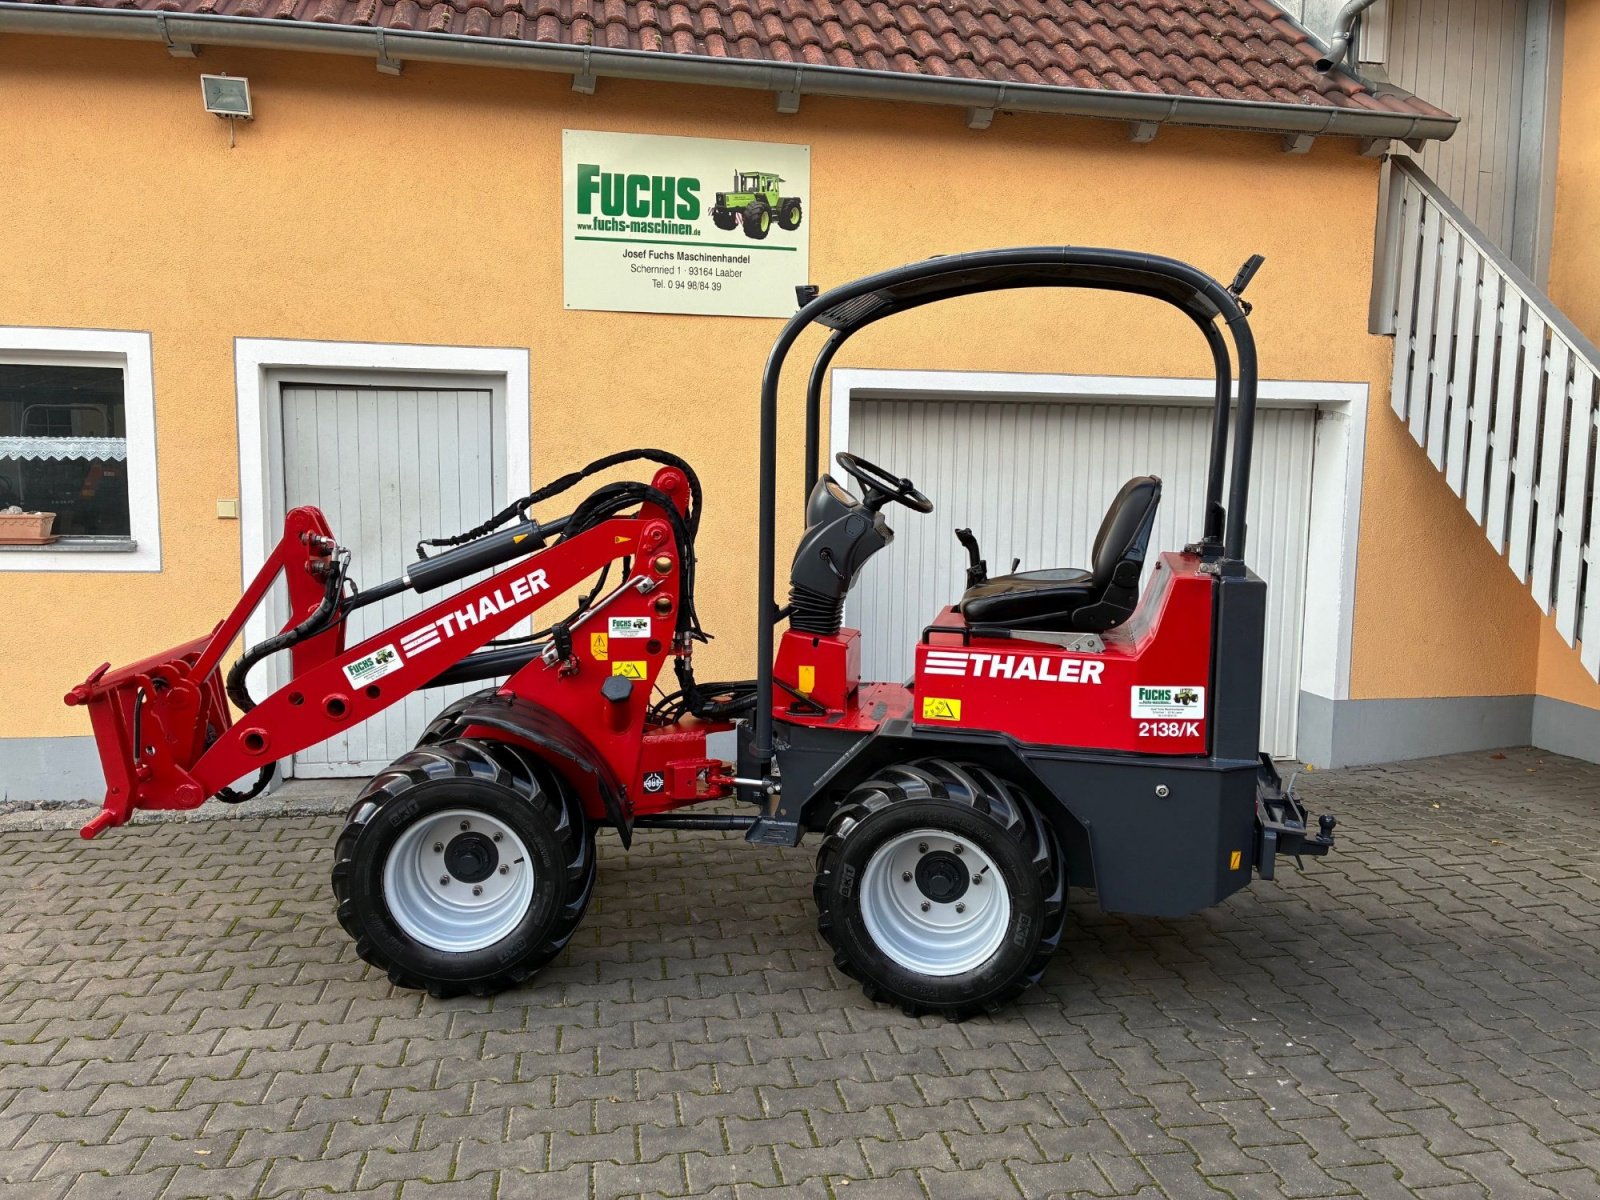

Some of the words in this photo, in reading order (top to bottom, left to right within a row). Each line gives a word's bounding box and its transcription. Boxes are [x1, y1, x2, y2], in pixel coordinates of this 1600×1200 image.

[577, 164, 701, 220] FUCHS
[577, 216, 701, 236] www.fuchs-maschinen.de
[622, 249, 646, 259] Josef
[648, 250, 674, 260] Fuchs
[677, 251, 751, 264] Maschinenhandel
[630, 263, 675, 275] Schernried
[677, 266, 681, 275] 1
[688, 266, 713, 276] 93164
[715, 268, 743, 278] Laaber
[652, 279, 666, 289] Tel.
[435, 568, 551, 638] THALER
[612, 619, 632, 627] FUCHS
[347, 657, 374, 676] FUCHS
[969, 653, 1105, 685] THALER
[1139, 687, 1172, 701] FUCHS
[1138, 722, 1200, 737] 2138/K
